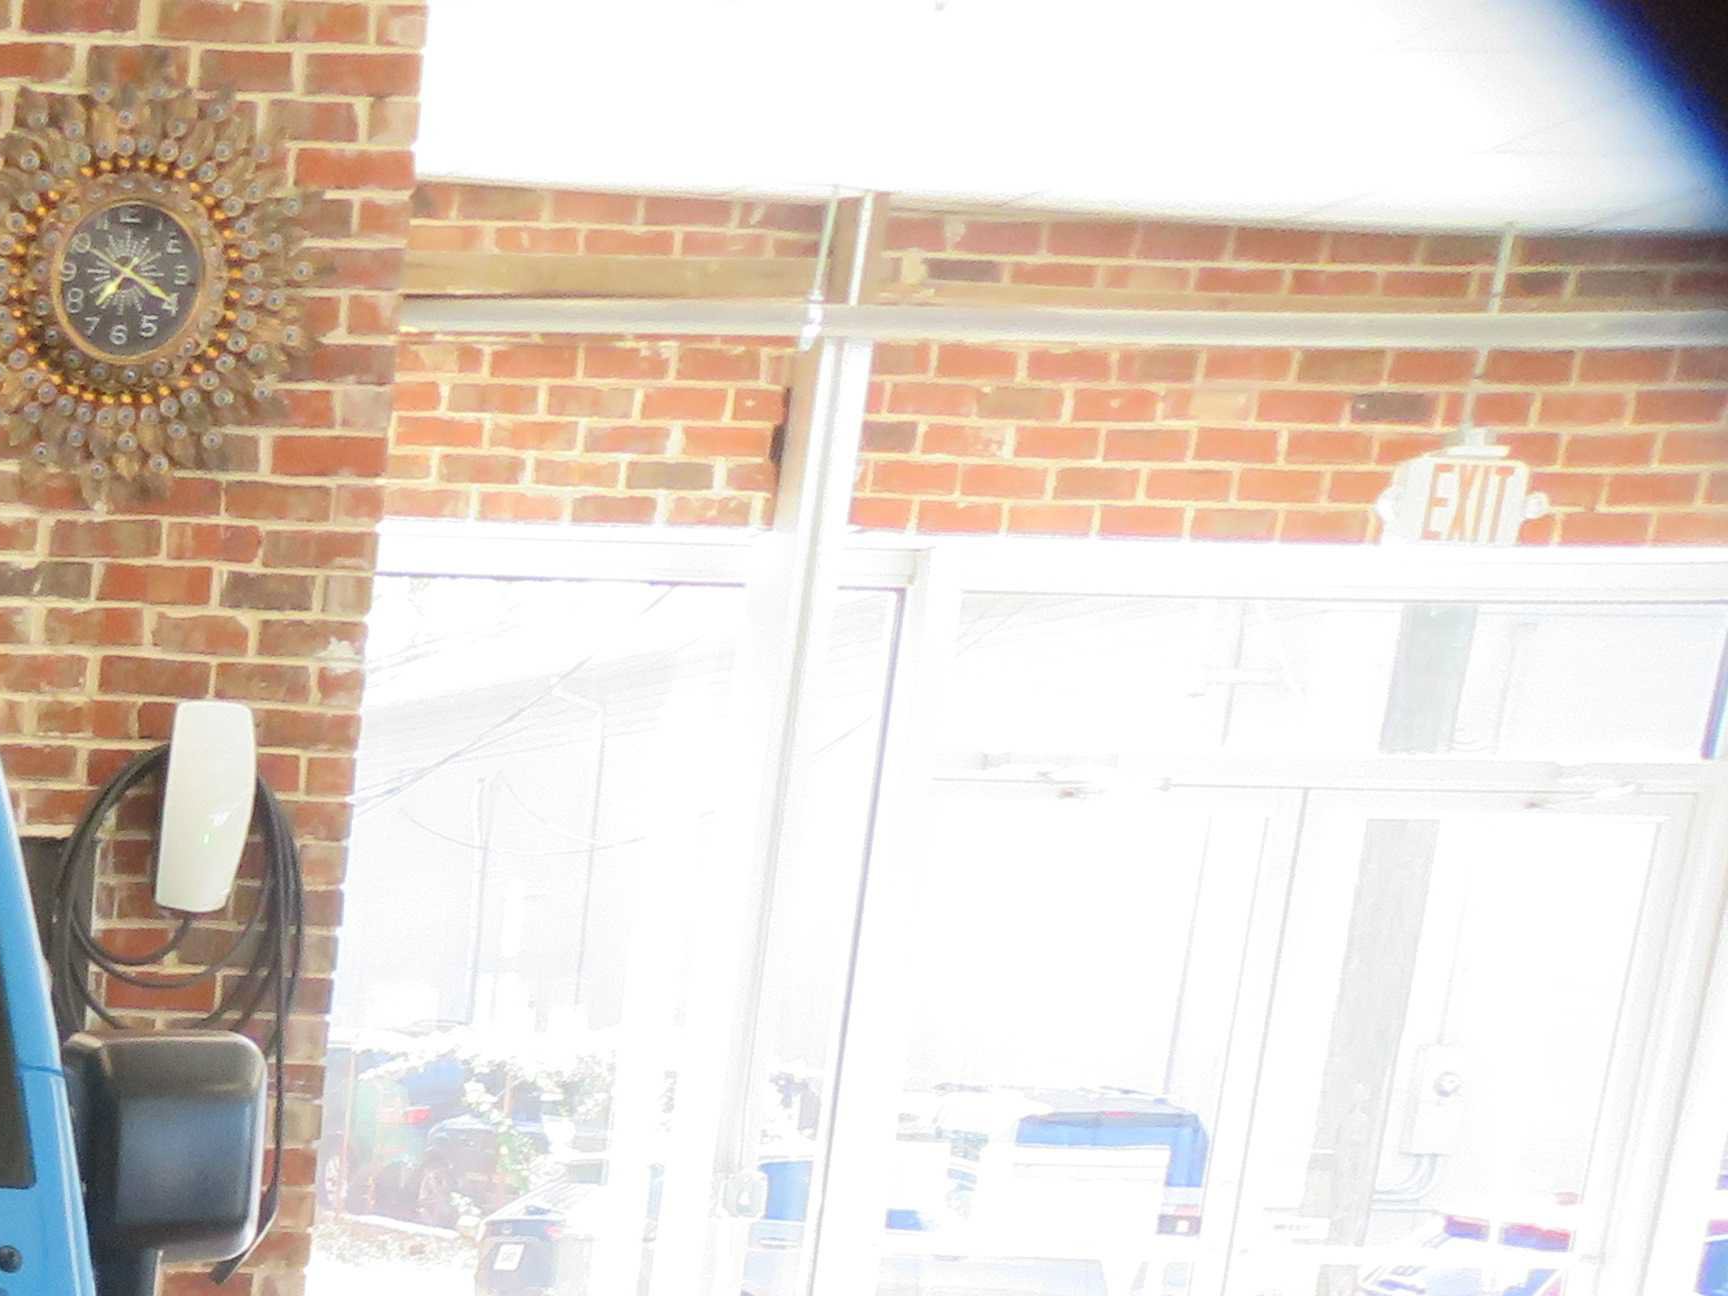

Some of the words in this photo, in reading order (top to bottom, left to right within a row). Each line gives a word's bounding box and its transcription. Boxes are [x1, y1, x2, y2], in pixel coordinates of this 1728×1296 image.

[60, 262, 77, 282] 9
[174, 265, 190, 285] 3
[66, 288, 84, 313] 8
[161, 291, 181, 317] 4
[83, 316, 101, 337] 7
[108, 324, 129, 346] 6
[138, 314, 159, 338] 5
[1421, 463, 1515, 542] EXIT
